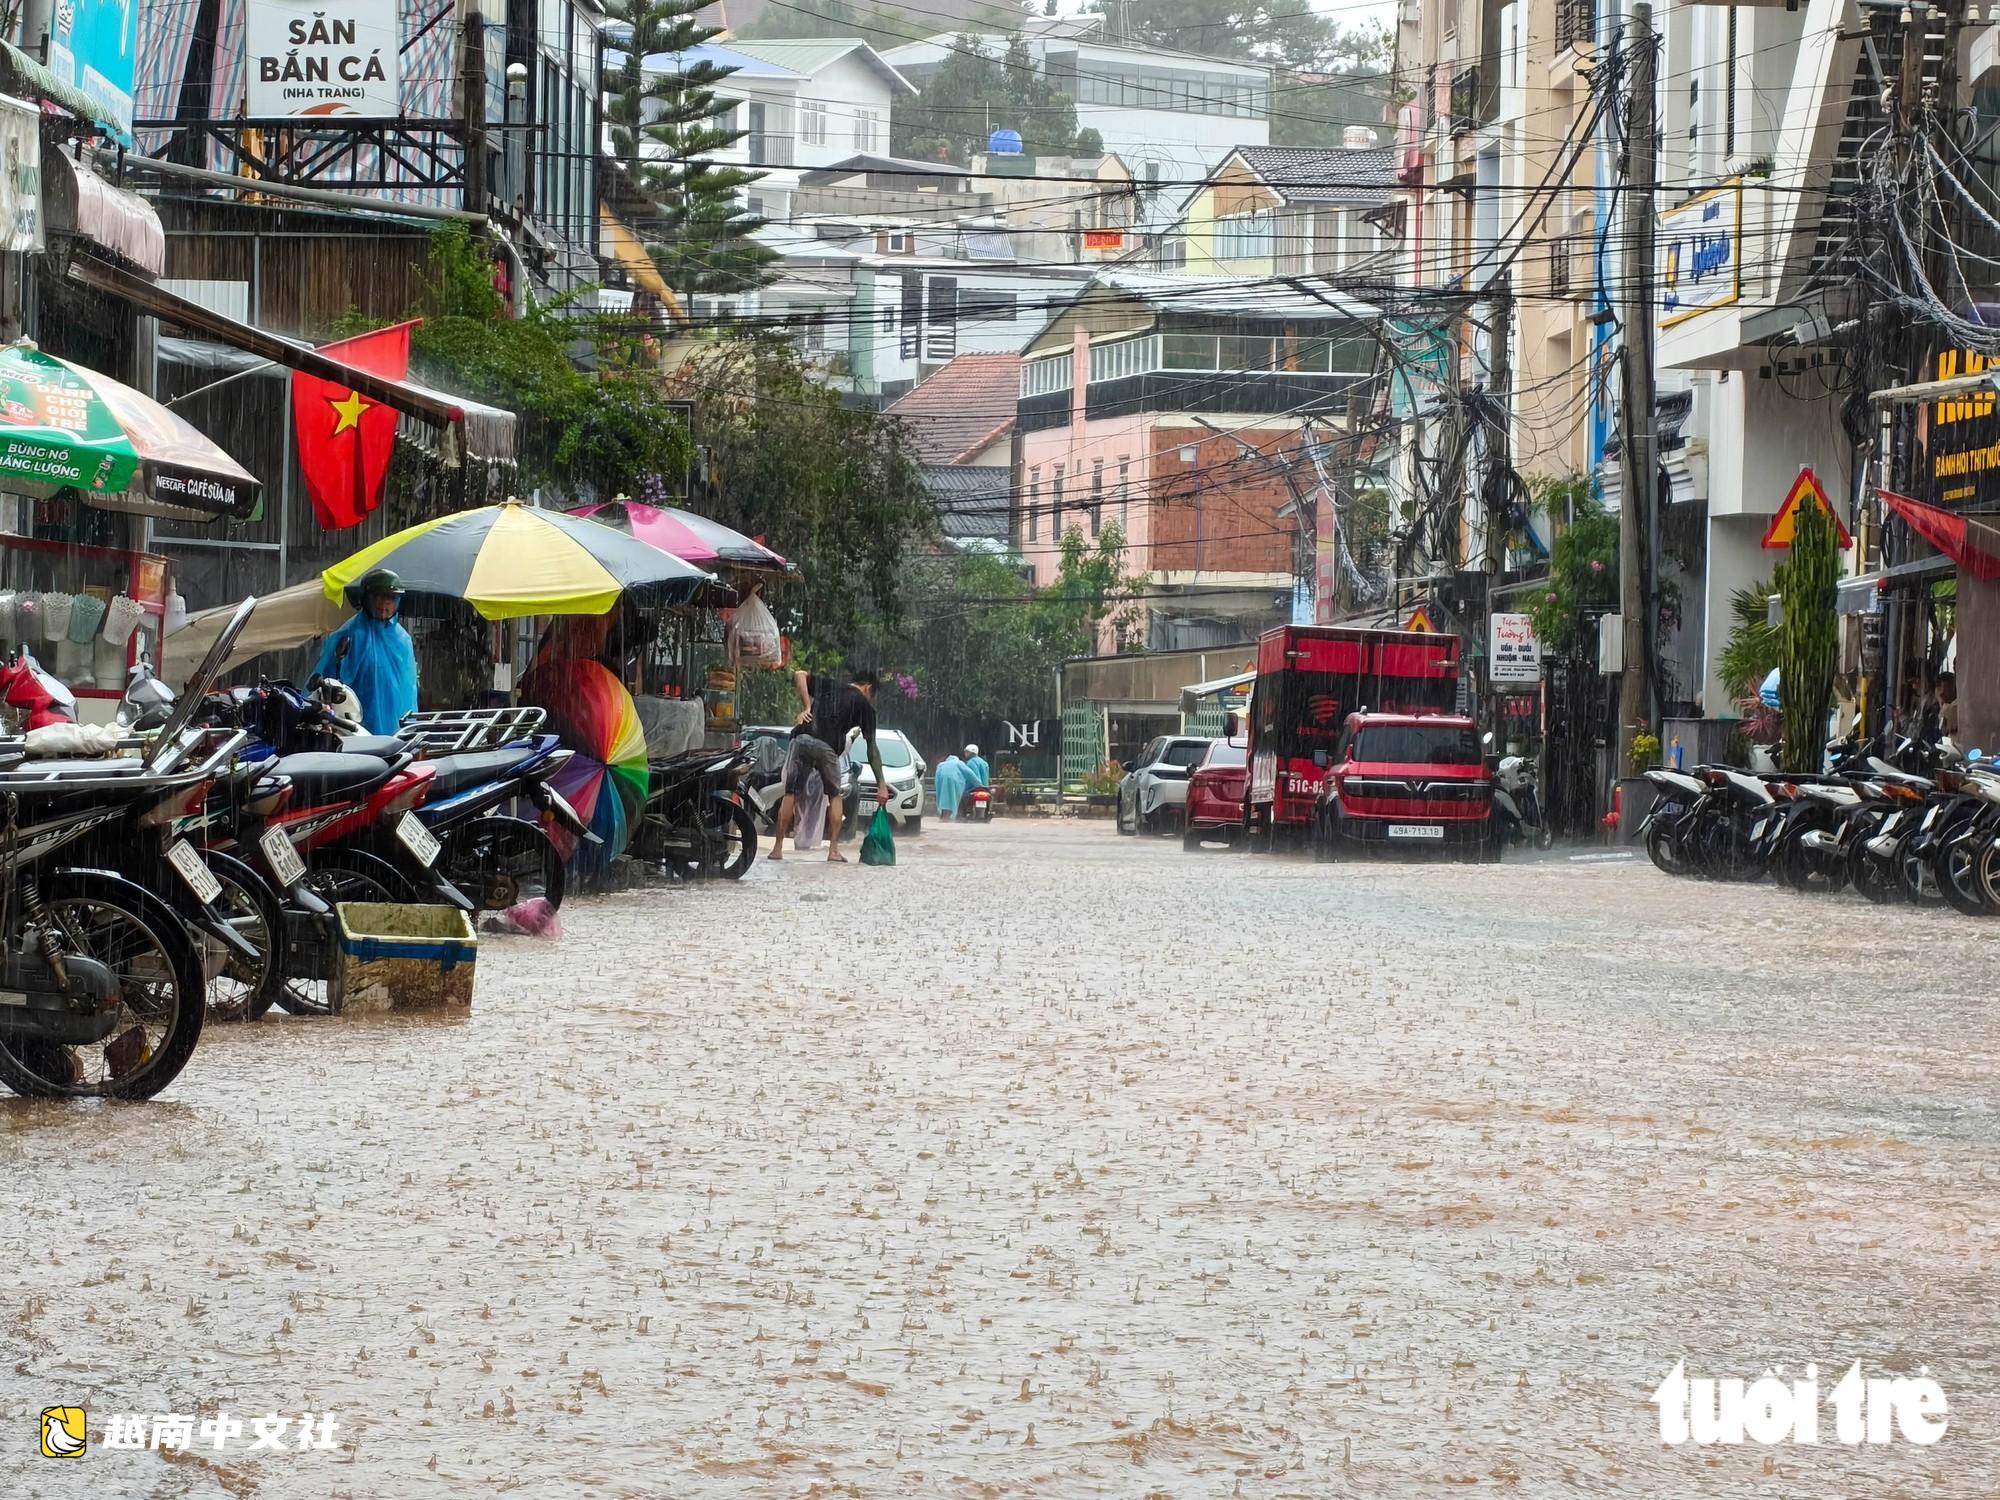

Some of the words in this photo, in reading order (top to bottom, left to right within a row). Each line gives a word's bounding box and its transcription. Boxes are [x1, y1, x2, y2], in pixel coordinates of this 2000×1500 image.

[288, 11, 355, 45] SĂN
[260, 48, 328, 82] BẮN
[338, 48, 386, 82] CÁ
[283, 87, 314, 99] (NHA
[317, 87, 365, 99] TRANG)
[7, 442, 46, 458] BÙNG
[33, 460, 80, 478] LƯỢNG
[187, 478, 208, 498] CAFÉ
[207, 482, 224, 501] SỮA
[32, 805, 130, 846] BLADE
[296, 802, 369, 833] BLADE
